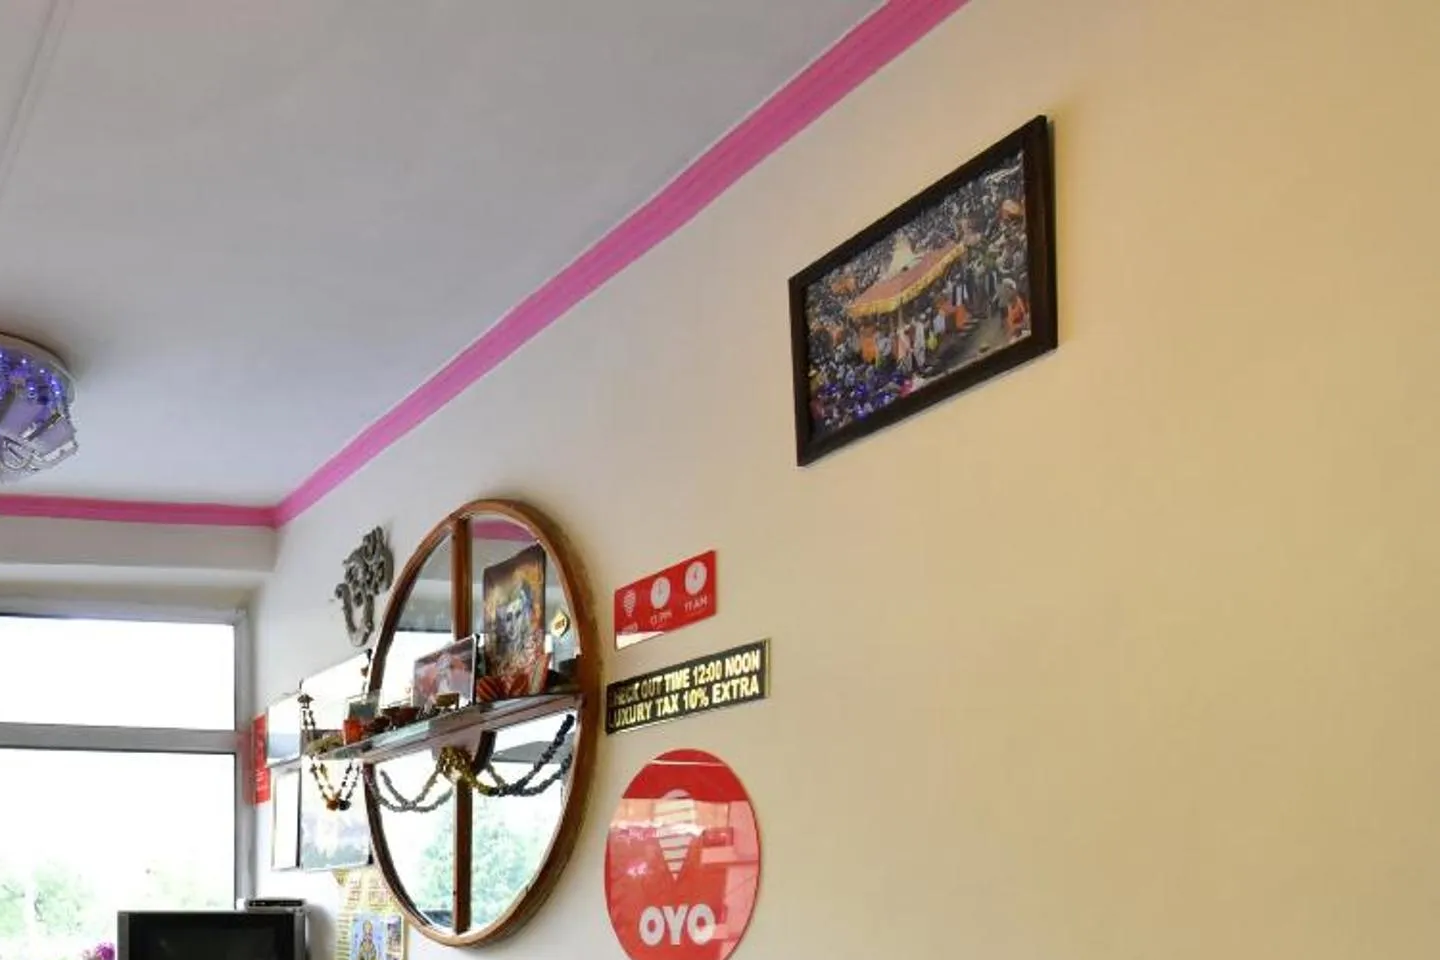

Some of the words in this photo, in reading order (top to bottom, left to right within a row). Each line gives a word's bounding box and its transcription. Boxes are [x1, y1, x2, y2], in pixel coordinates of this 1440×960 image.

[640, 676, 663, 700] OUT
[664, 667, 690, 691] TIME
[693, 661, 722, 684] 12:00
[725, 650, 760, 678] NOON
[610, 702, 652, 728] UXURY
[656, 692, 679, 716] TAX
[683, 687, 709, 710] 10%
[712, 674, 760, 704] EXTRA
[639, 904, 715, 946] OYO
